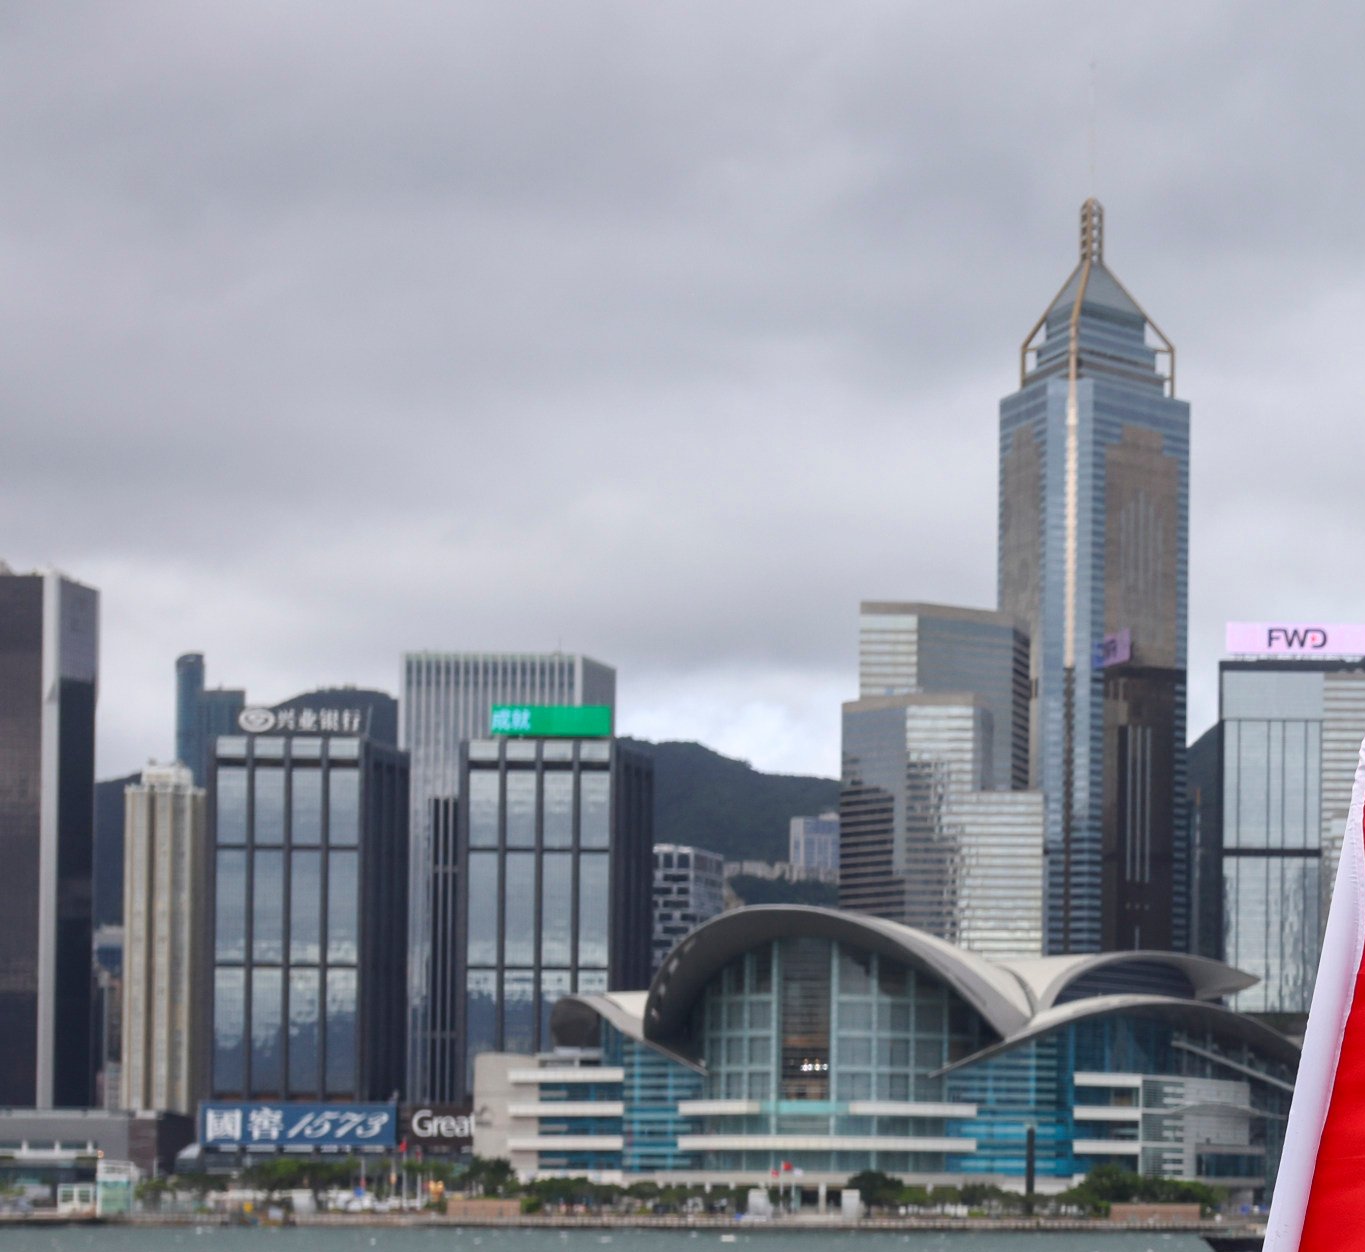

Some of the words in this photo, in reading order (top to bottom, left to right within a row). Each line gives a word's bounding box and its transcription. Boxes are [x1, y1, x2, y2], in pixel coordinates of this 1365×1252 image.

[1267, 629, 1327, 649] FWD
[277, 707, 361, 731] 兴业银行
